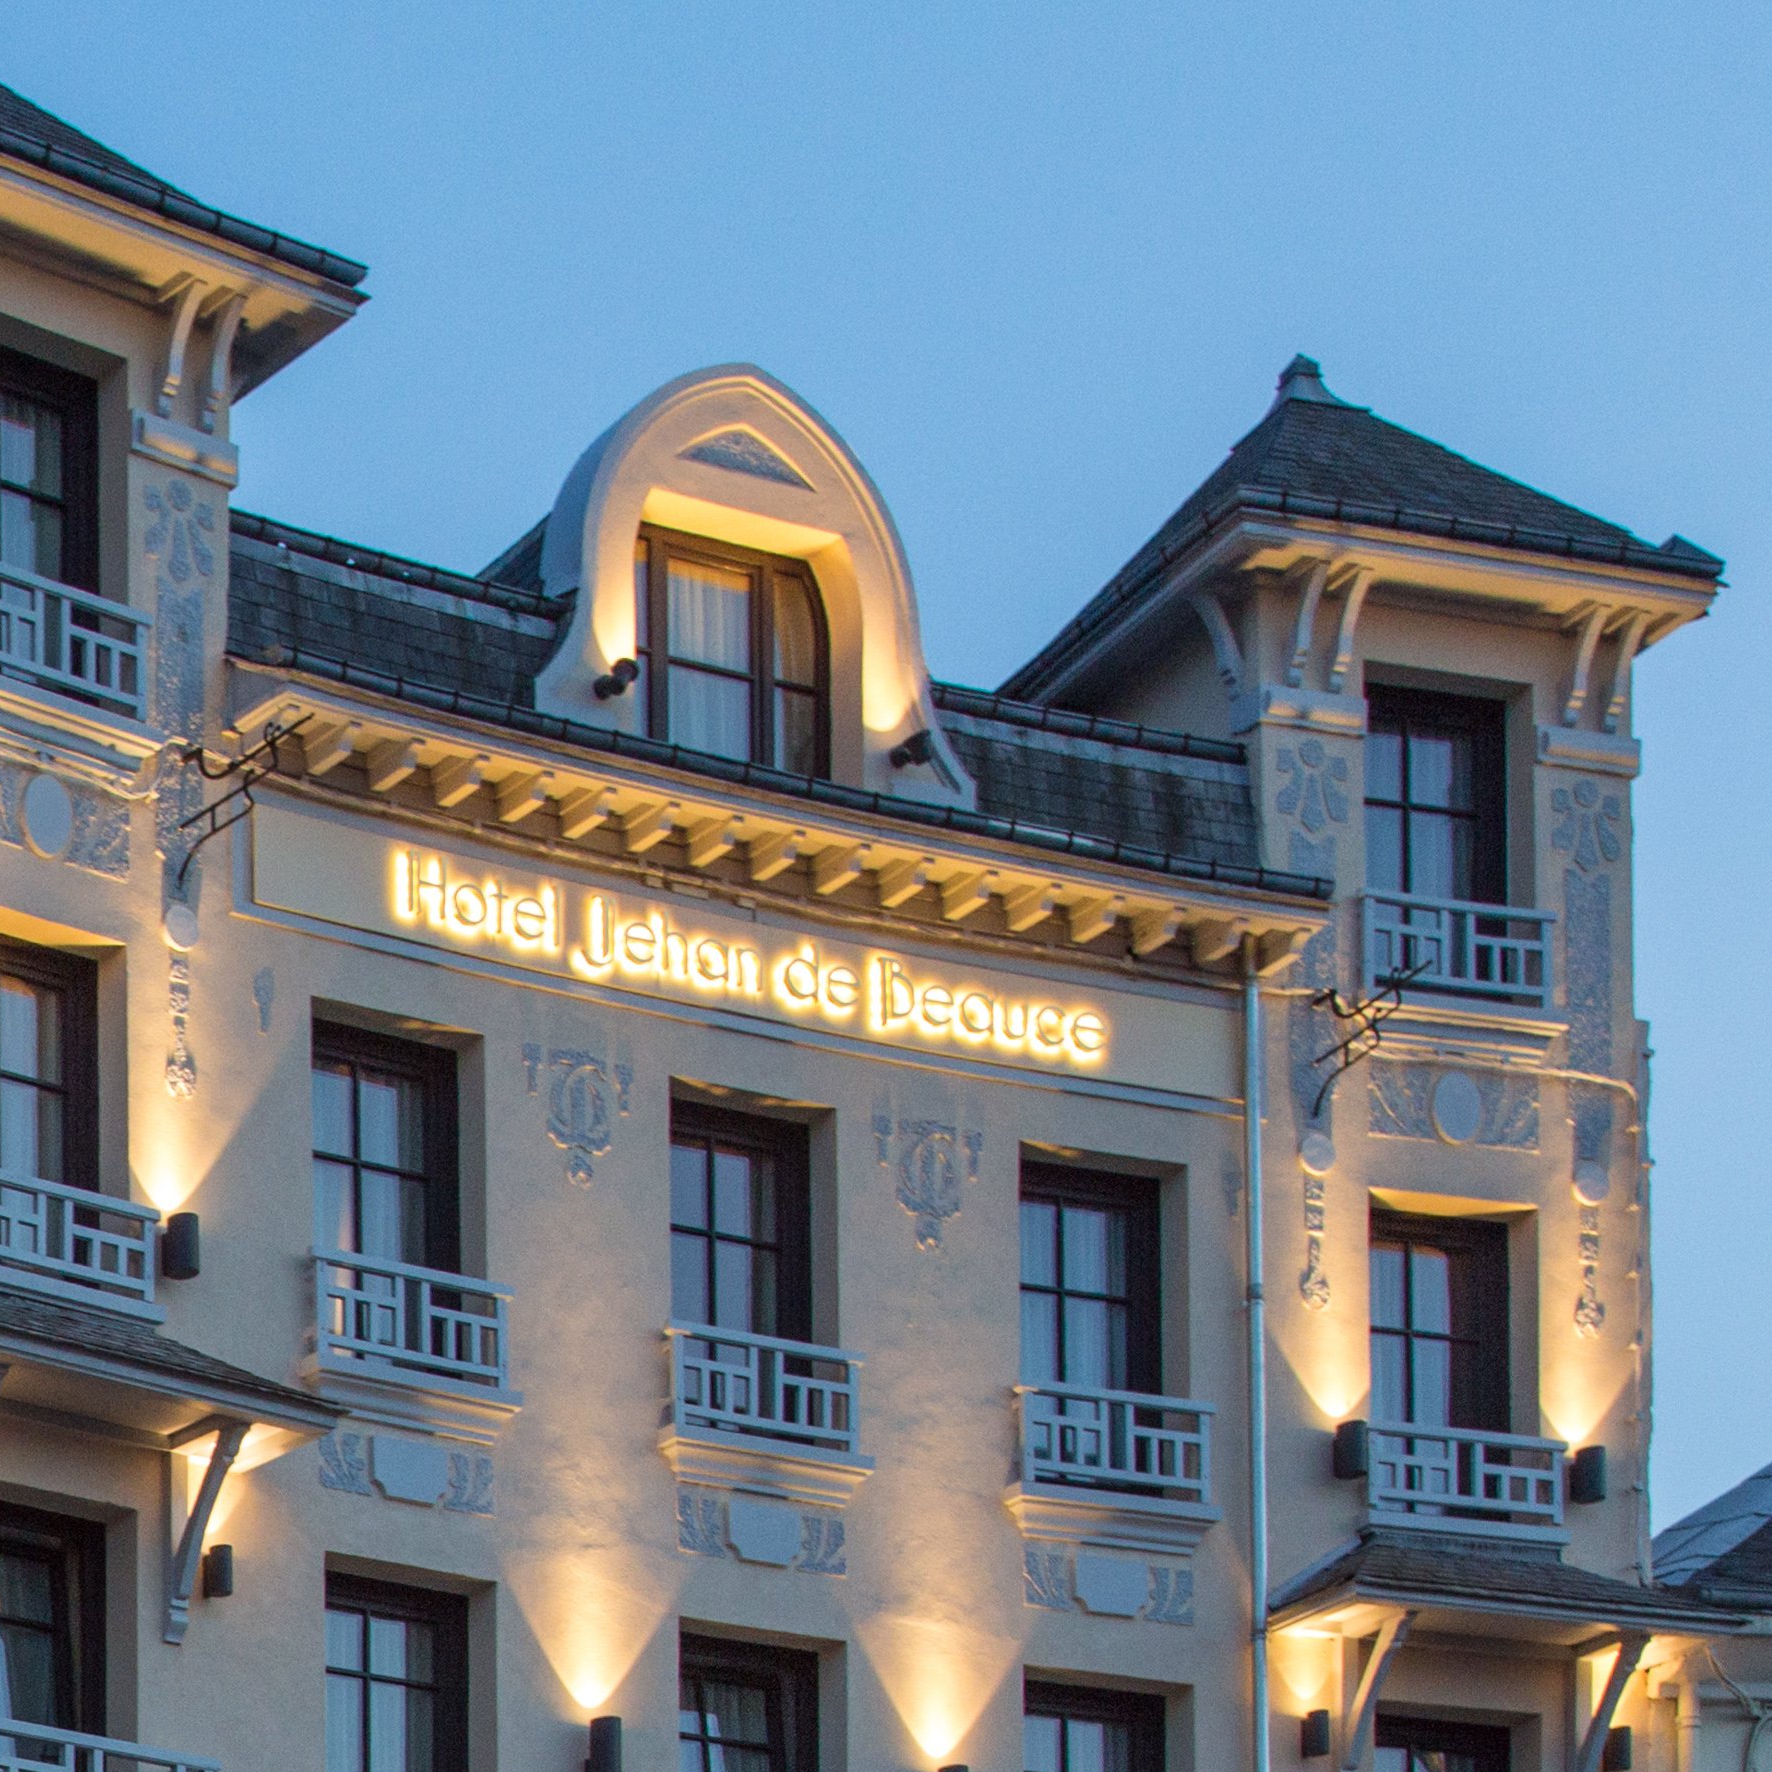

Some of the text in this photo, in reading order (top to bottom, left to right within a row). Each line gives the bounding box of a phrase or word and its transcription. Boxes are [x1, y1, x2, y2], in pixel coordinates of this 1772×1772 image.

[397, 847, 1107, 1060] Hotel Jehan de Beauce
